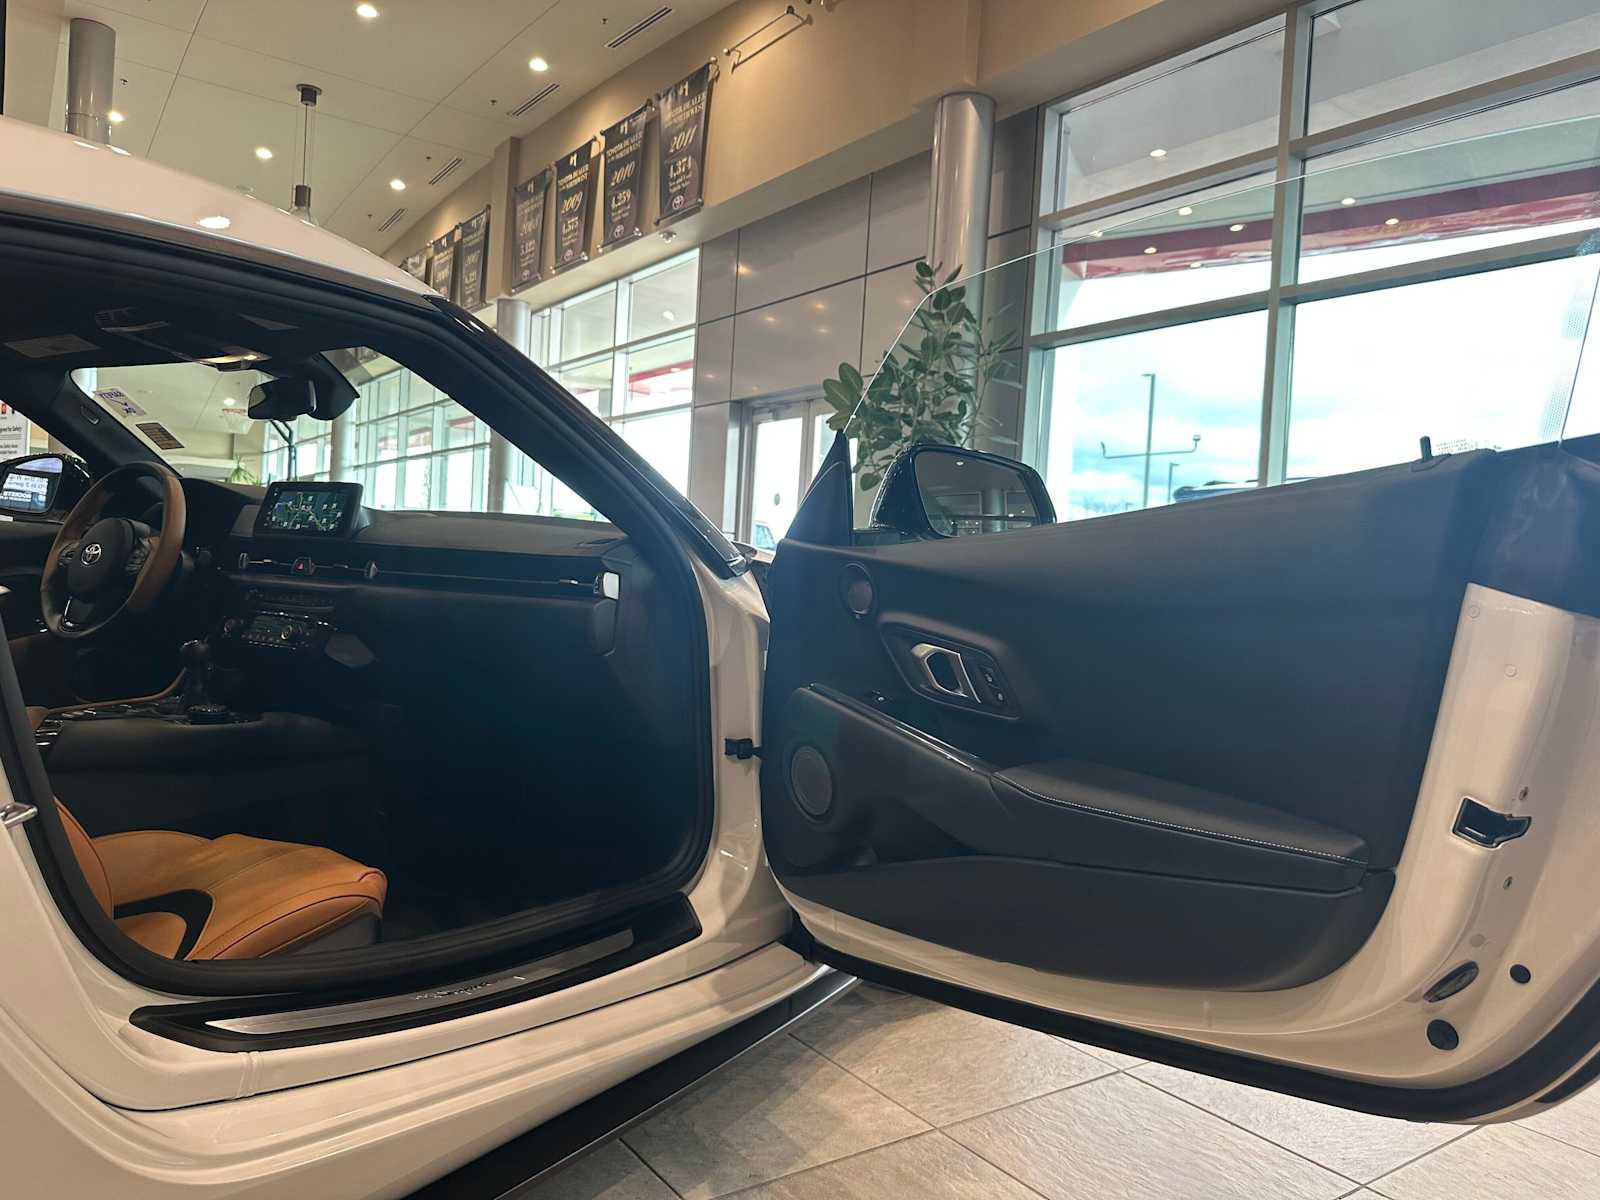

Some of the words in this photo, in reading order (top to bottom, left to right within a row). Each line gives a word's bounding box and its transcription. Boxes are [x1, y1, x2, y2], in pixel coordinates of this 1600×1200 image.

[669, 124, 697, 153] 2011
[610, 161, 636, 187] 2010
[561, 192, 583, 214] 2009
